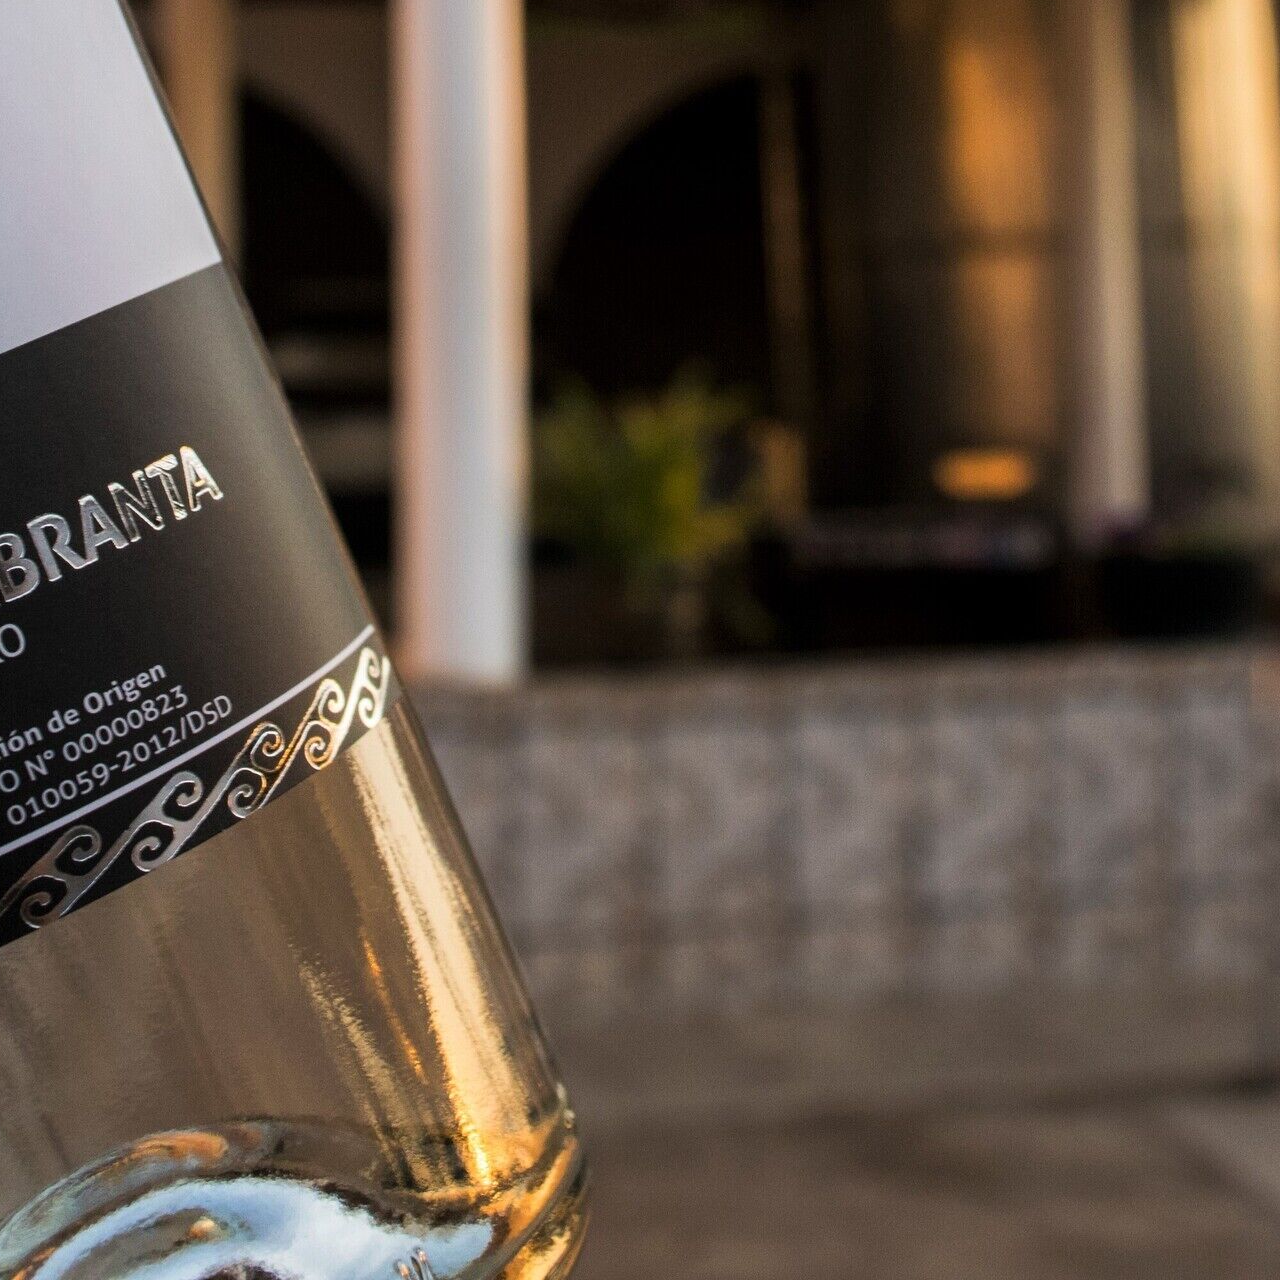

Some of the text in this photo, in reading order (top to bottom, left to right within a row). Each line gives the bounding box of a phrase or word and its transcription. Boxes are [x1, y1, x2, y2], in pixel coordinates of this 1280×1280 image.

[47, 709, 80, 734] de
[82, 664, 167, 714] Origen
[62, 684, 189, 762] 00000823
[6, 695, 233, 826] 010059-2012/DSD
